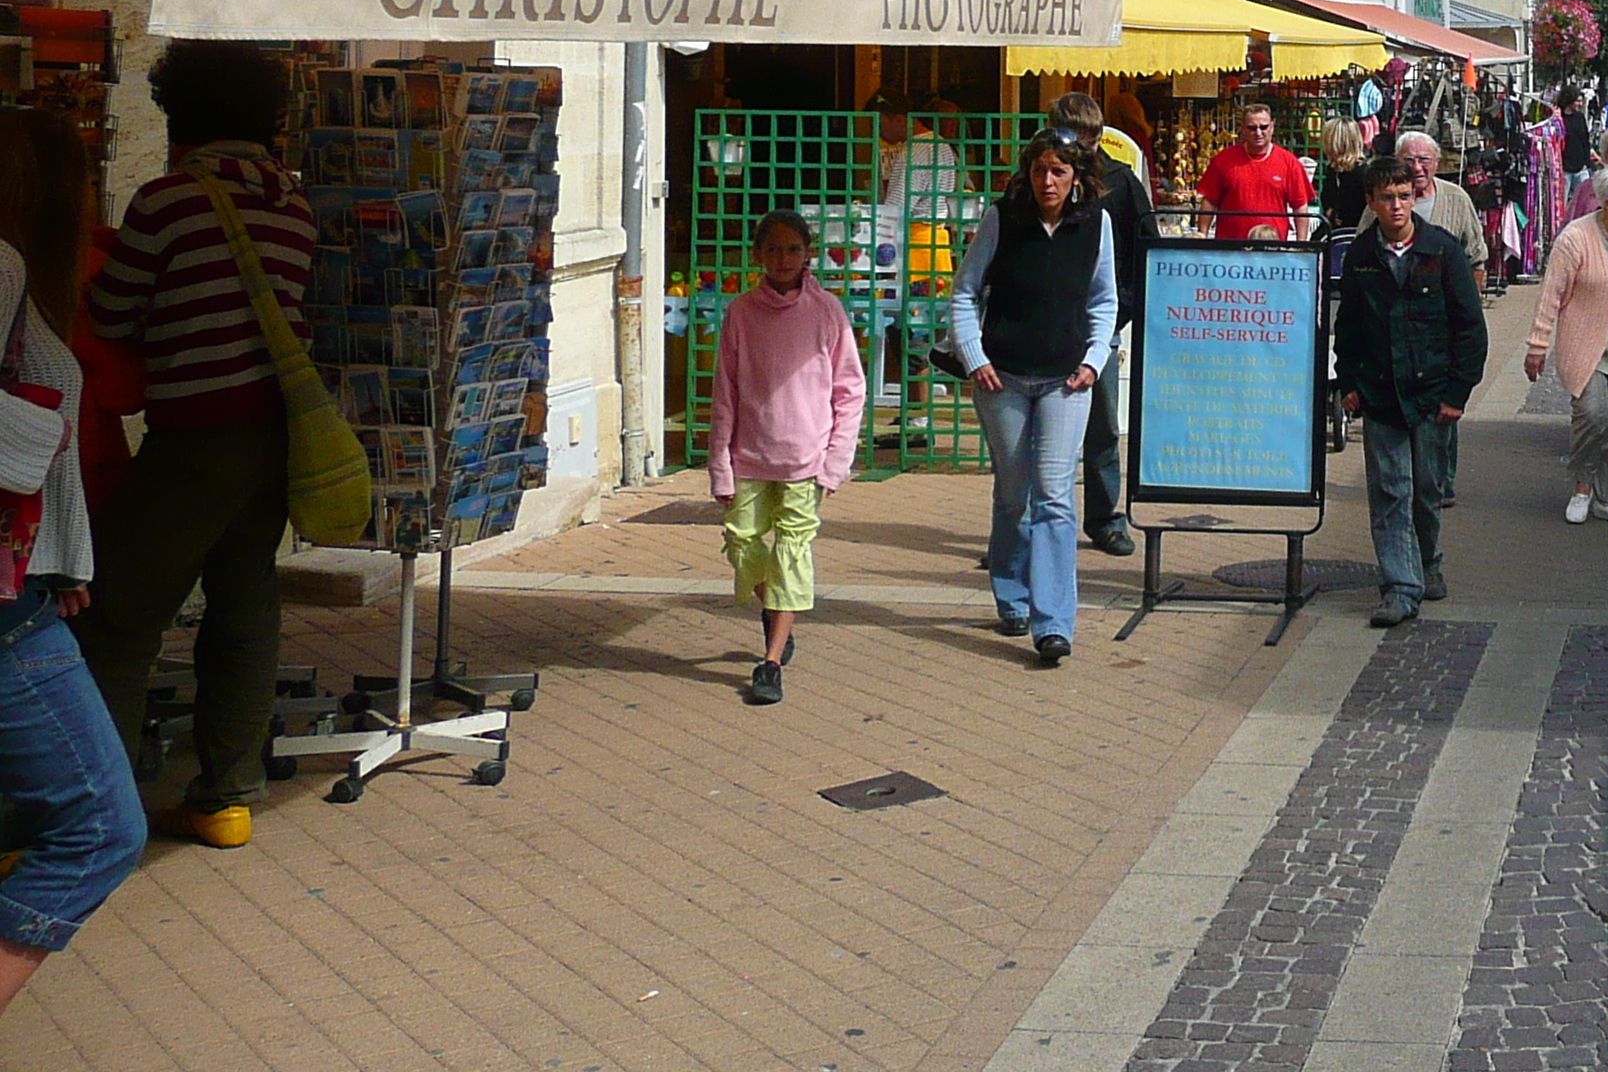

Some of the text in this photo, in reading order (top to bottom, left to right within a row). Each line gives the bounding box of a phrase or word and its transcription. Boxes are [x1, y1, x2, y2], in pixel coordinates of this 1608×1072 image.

[1155, 261, 1311, 283] PHOTOGRAPHE
[1194, 288, 1267, 306] BORNE
[1166, 306, 1296, 328] NUMERIQUE
[1170, 326, 1289, 344] SELF-SERVICE
[1263, 356, 1287, 369] CD
